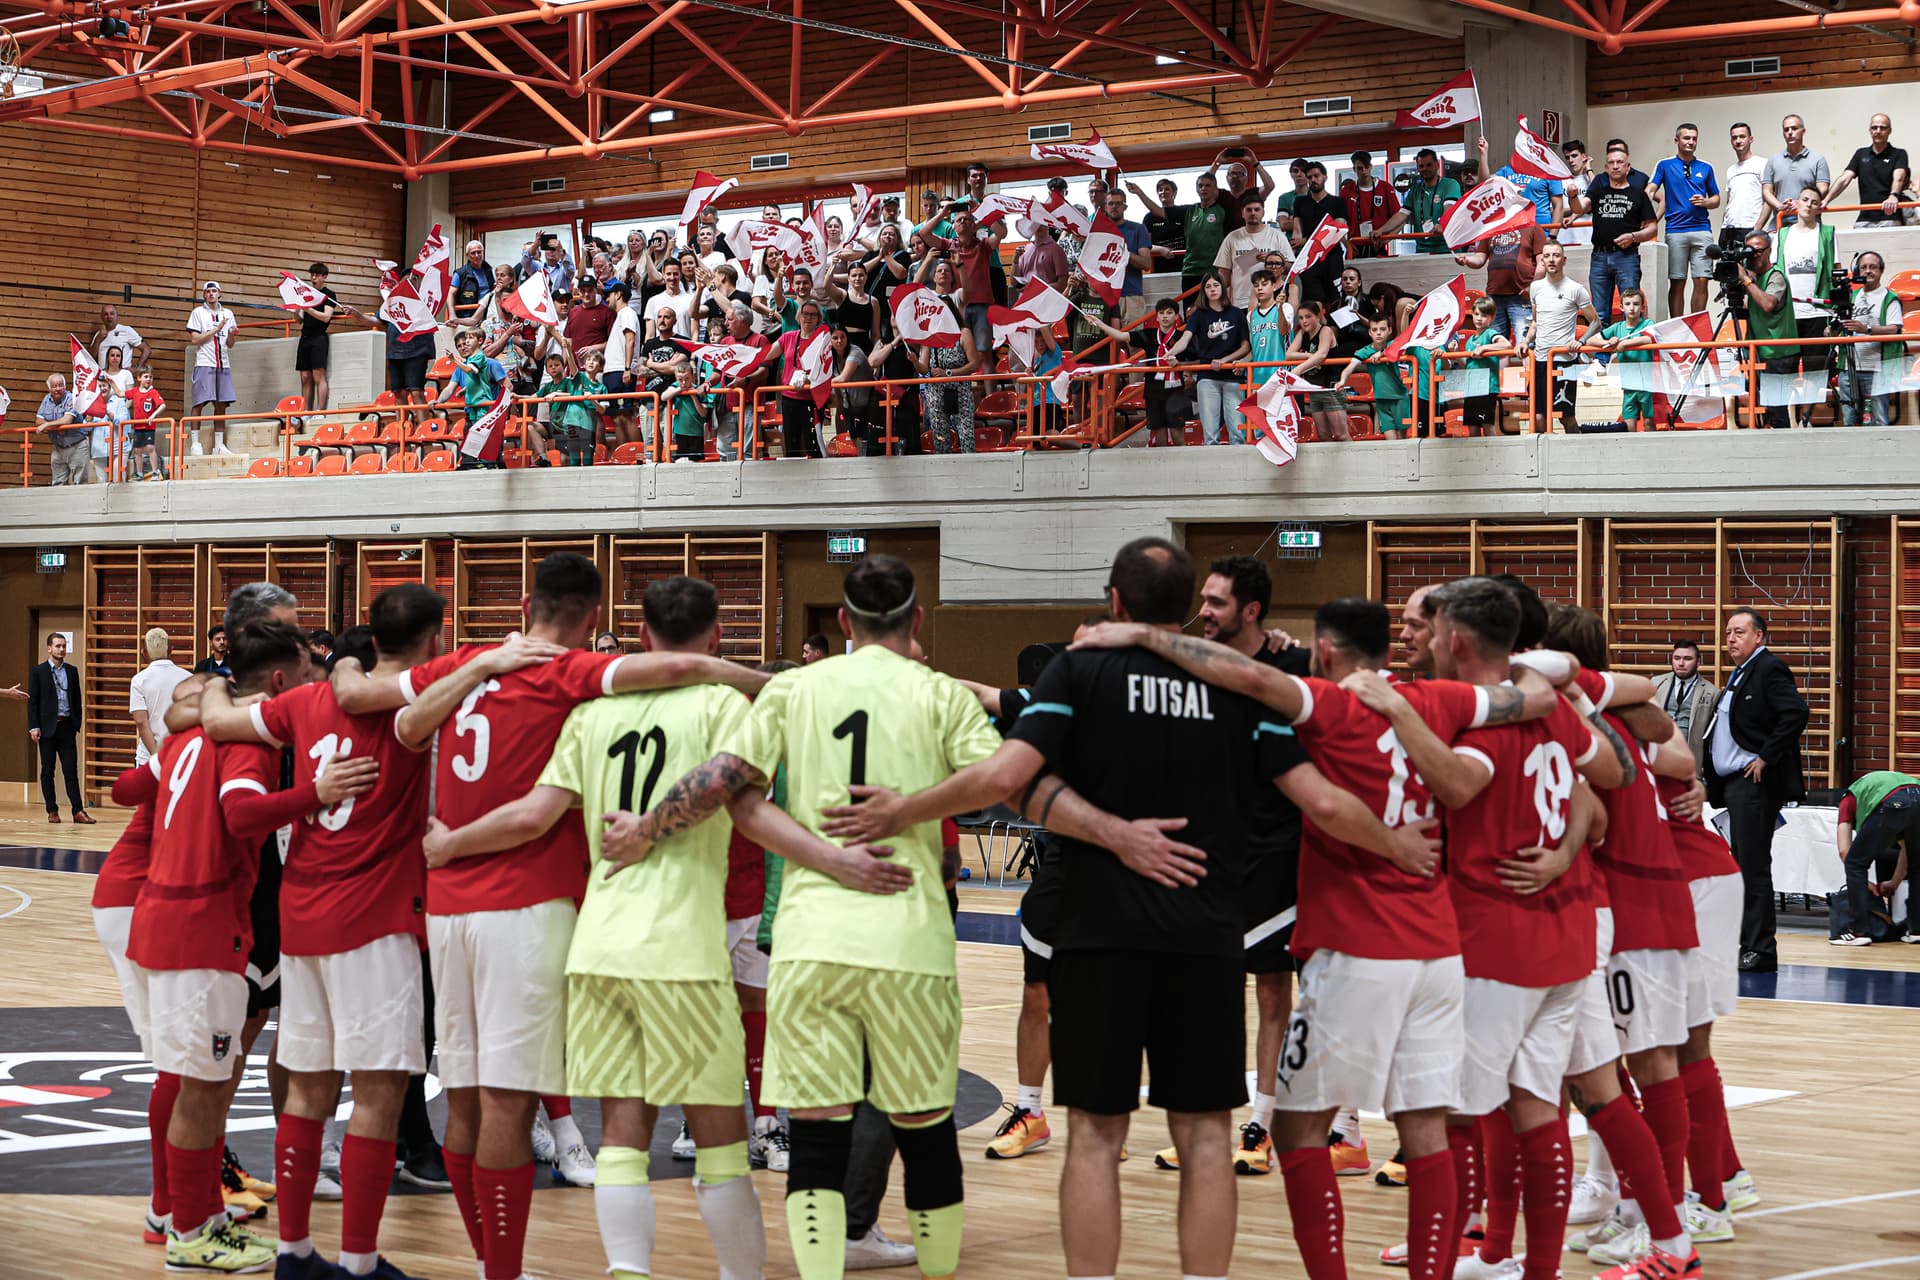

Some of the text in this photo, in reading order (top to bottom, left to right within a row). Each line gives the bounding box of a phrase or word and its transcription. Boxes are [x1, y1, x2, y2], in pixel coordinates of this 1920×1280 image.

[1467, 187, 1505, 222] Stiegl
[1260, 336, 1266, 347] 3
[451, 679, 501, 782] 5
[1127, 674, 1214, 720] FUTSAL
[164, 736, 203, 830] 9
[607, 725, 667, 815] 12
[832, 709, 868, 801] 1
